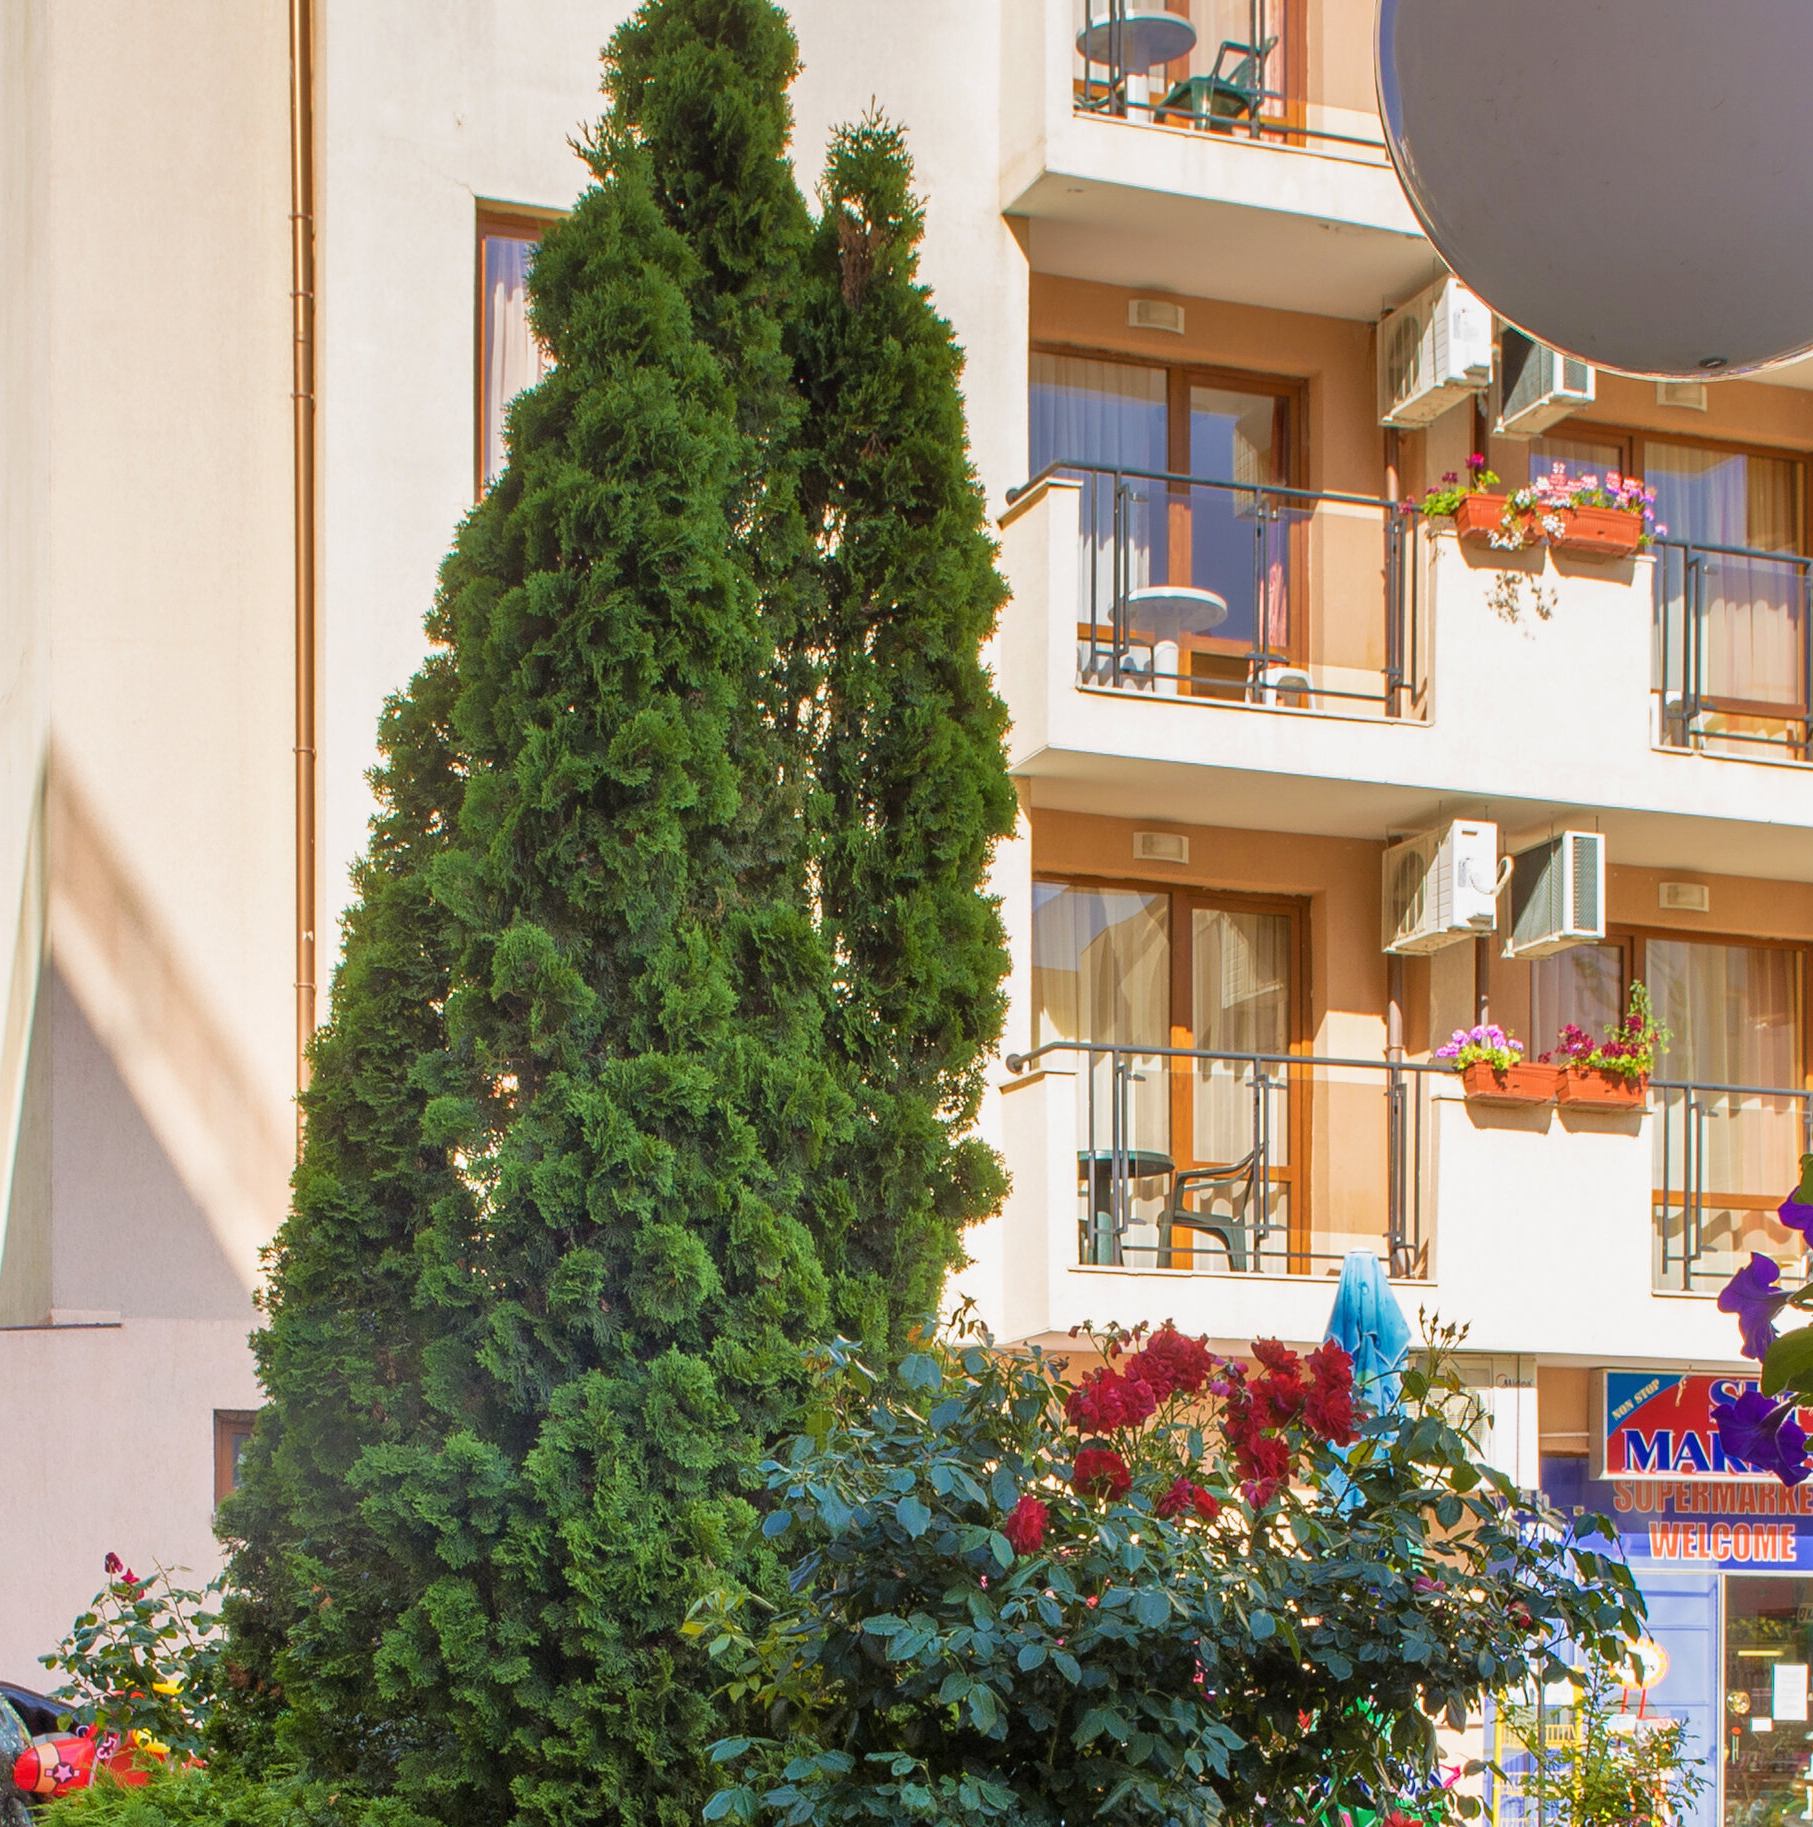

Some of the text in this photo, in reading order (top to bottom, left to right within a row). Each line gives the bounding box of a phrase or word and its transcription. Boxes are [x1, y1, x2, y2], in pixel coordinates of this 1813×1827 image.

[1611, 1378, 1660, 1421] NON STOP
[1648, 1521, 1797, 1563] WELCOME
